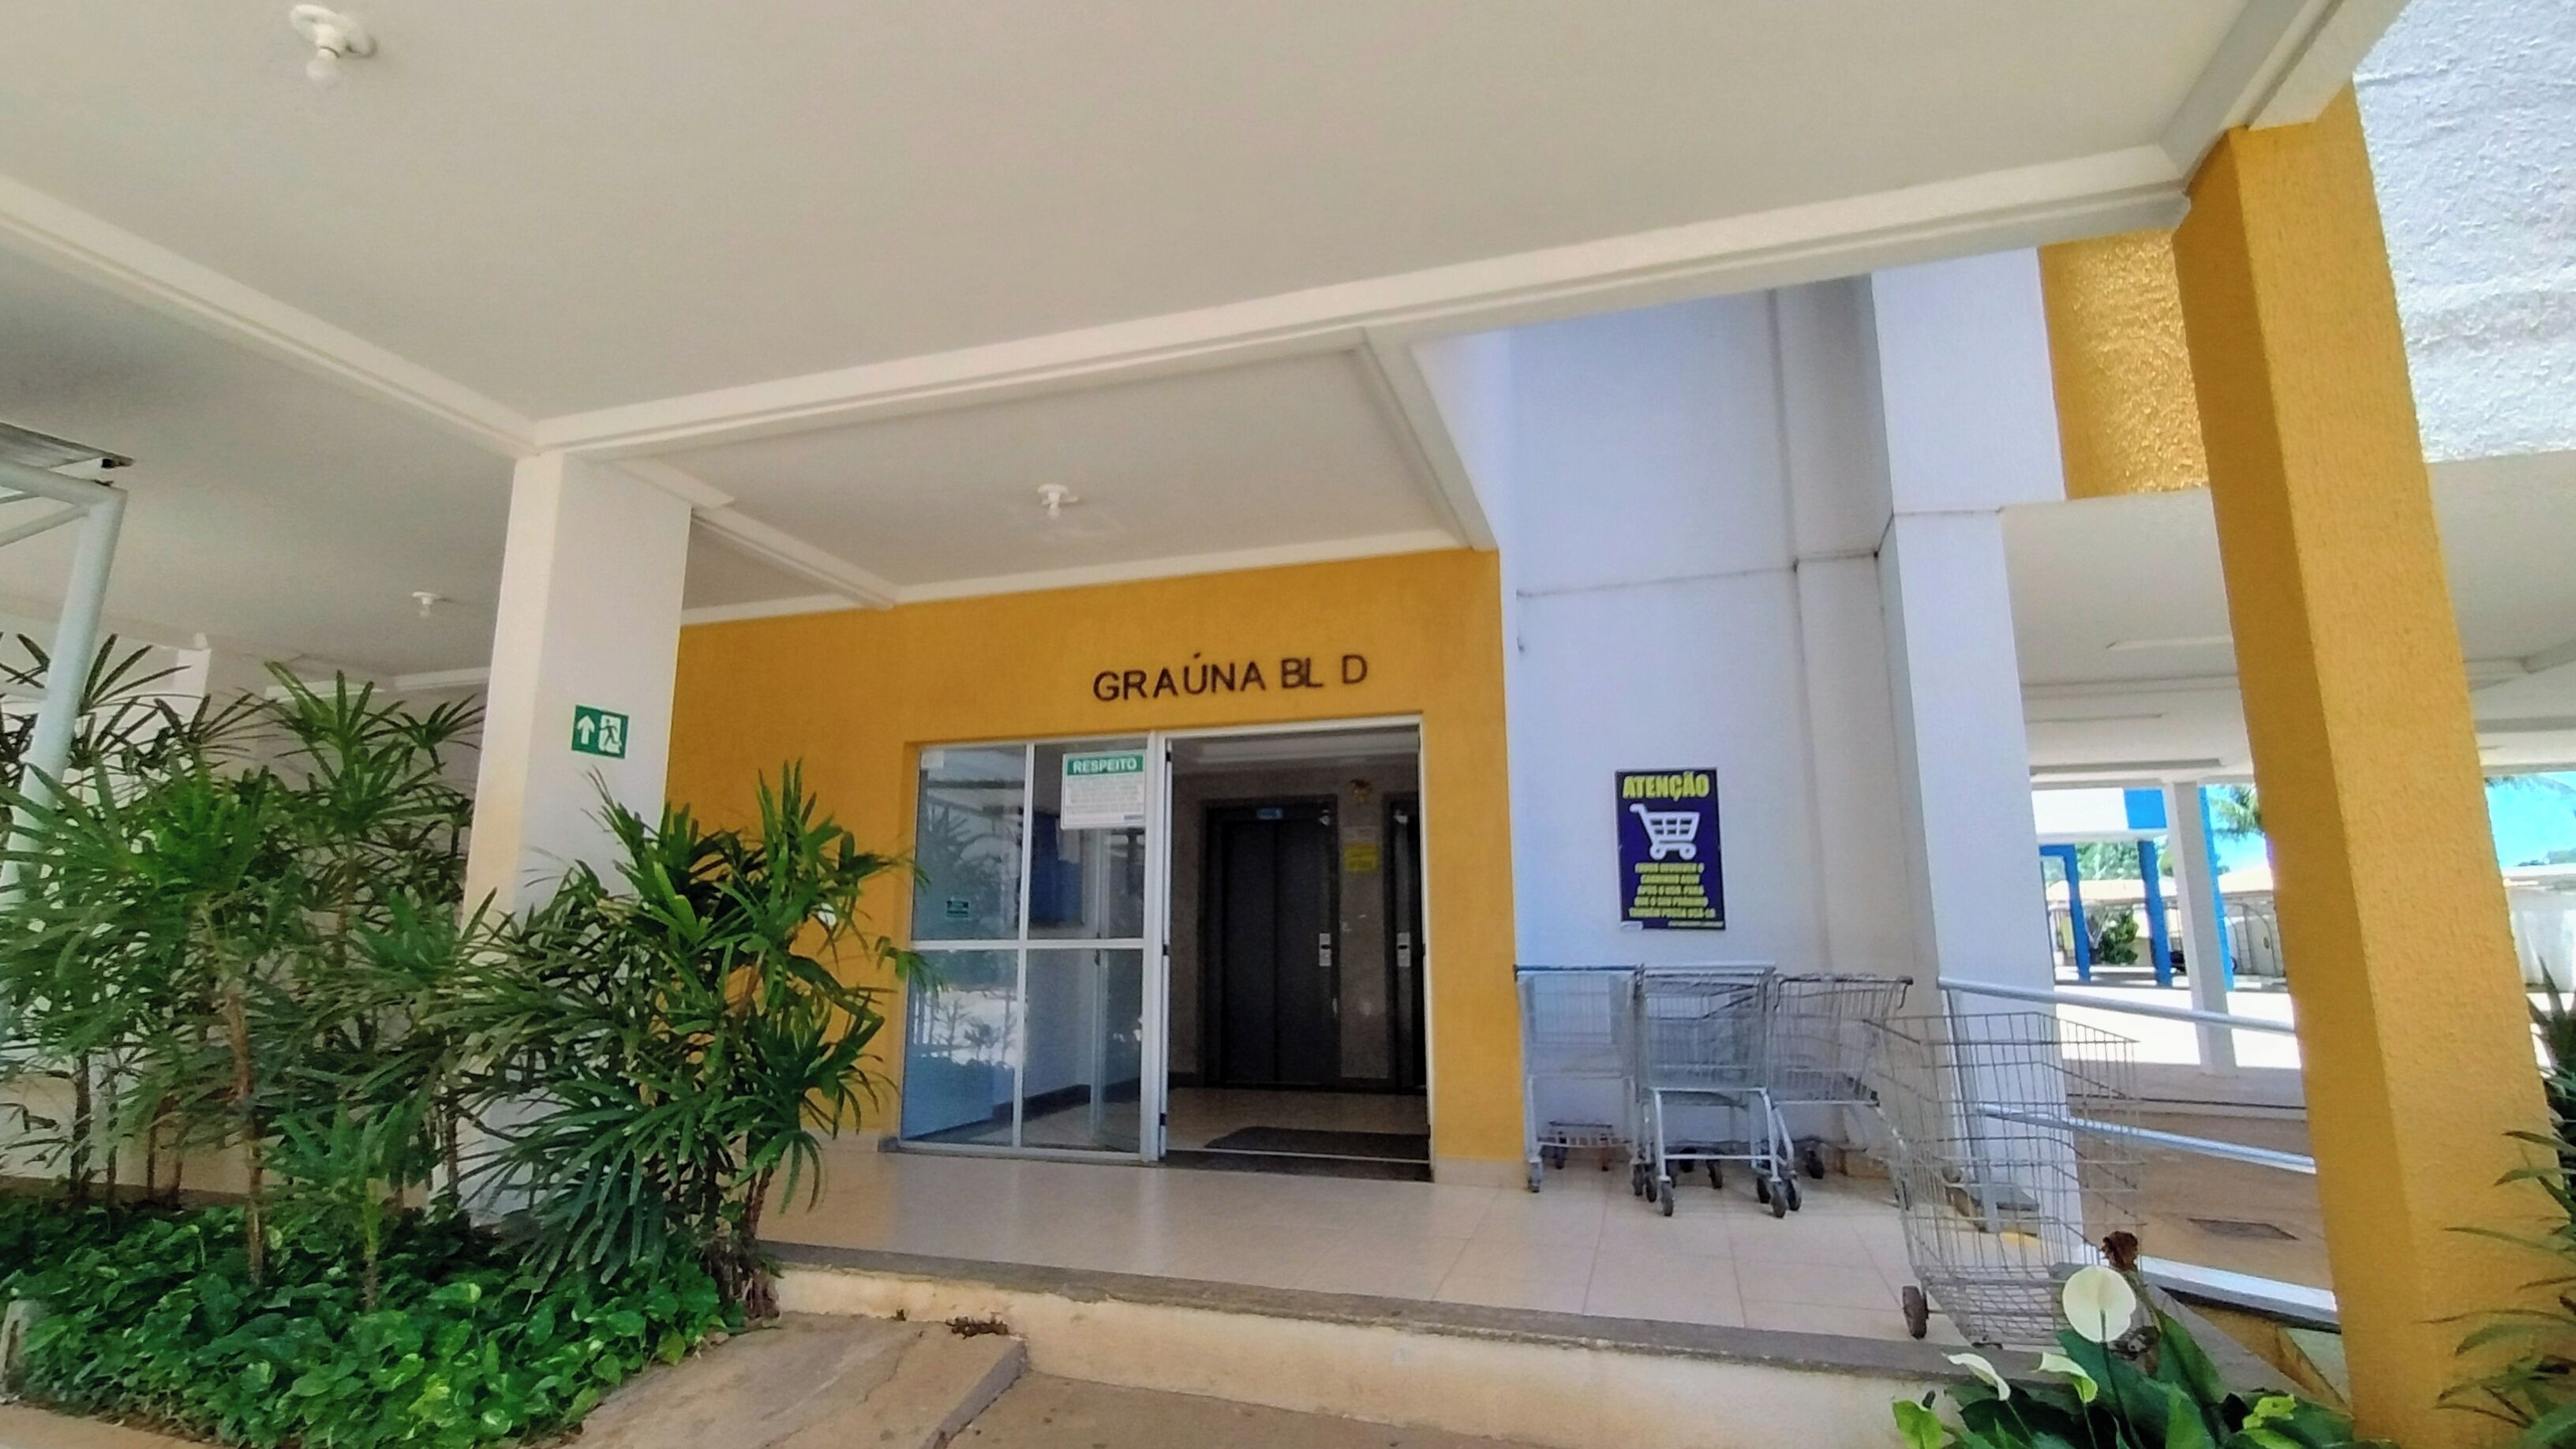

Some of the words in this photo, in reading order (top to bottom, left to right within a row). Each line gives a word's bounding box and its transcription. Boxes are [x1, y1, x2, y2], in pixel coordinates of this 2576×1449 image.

[1093, 652, 1266, 702] GRAÚNA
[1281, 657, 1323, 689] BL
[1342, 654, 1368, 684] D
[1073, 757, 1137, 774] RESPEITO
[1622, 771, 1710, 802] ATENÇÃO
